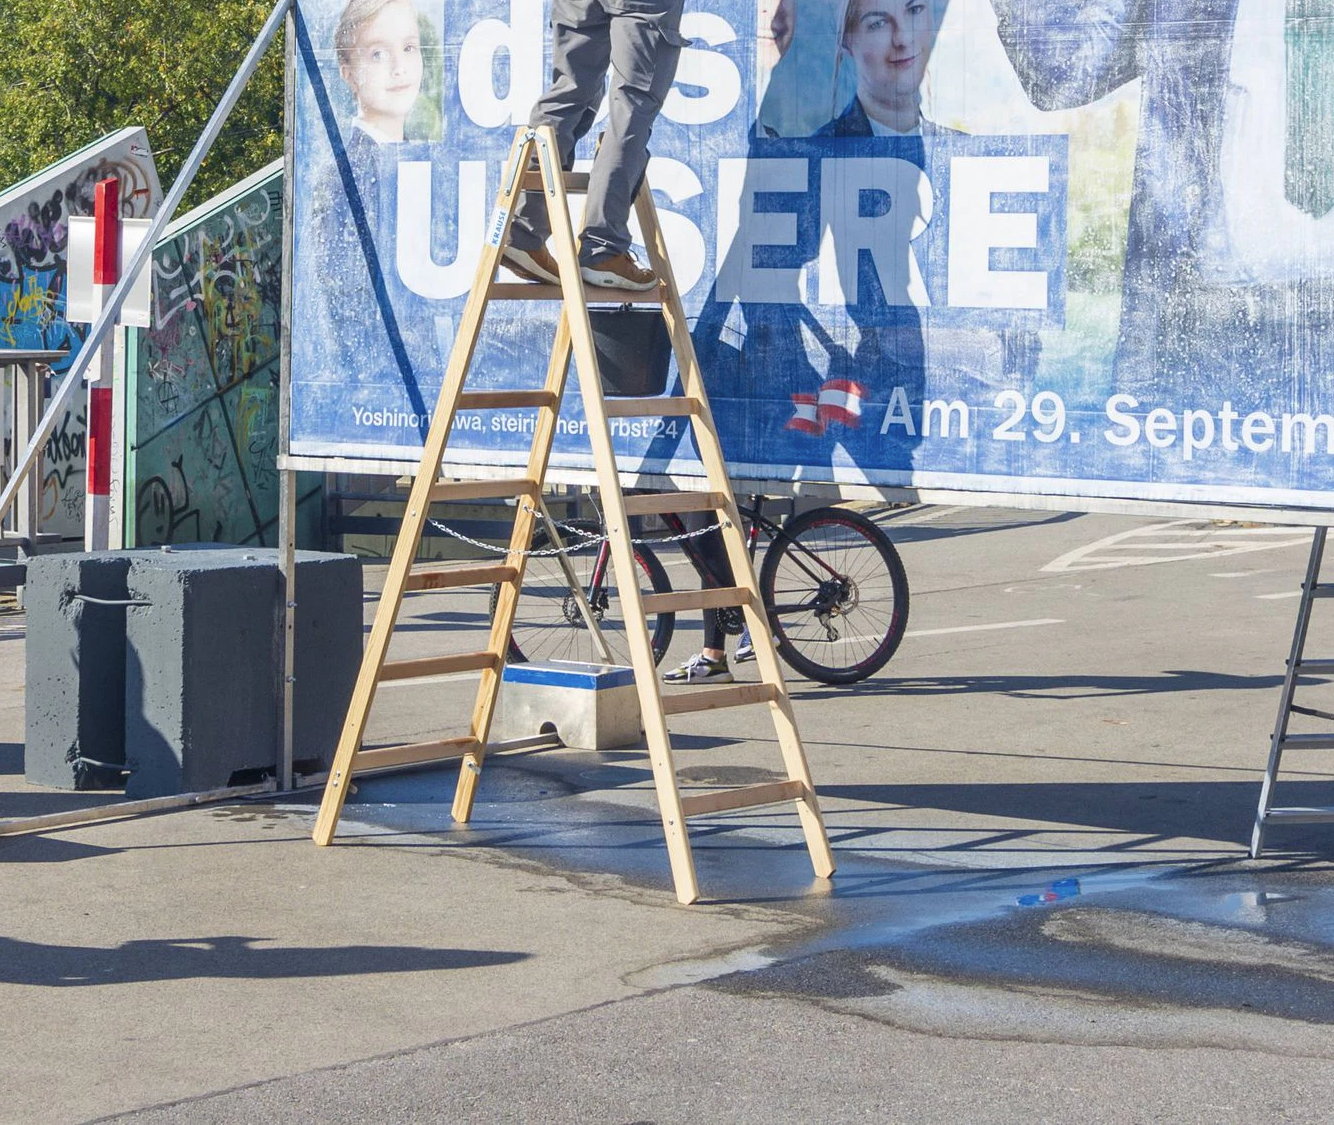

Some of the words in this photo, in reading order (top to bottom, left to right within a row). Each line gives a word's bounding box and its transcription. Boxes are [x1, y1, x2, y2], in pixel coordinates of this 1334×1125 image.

[396, 156, 1050, 310] USERE
[491, 210, 507, 245] KRAUSE
[352, 406, 432, 428] Yoshinori
[610, 416, 678, 439] rbst'24
[880, 386, 969, 438] Am
[993, 389, 1081, 444] 29.
